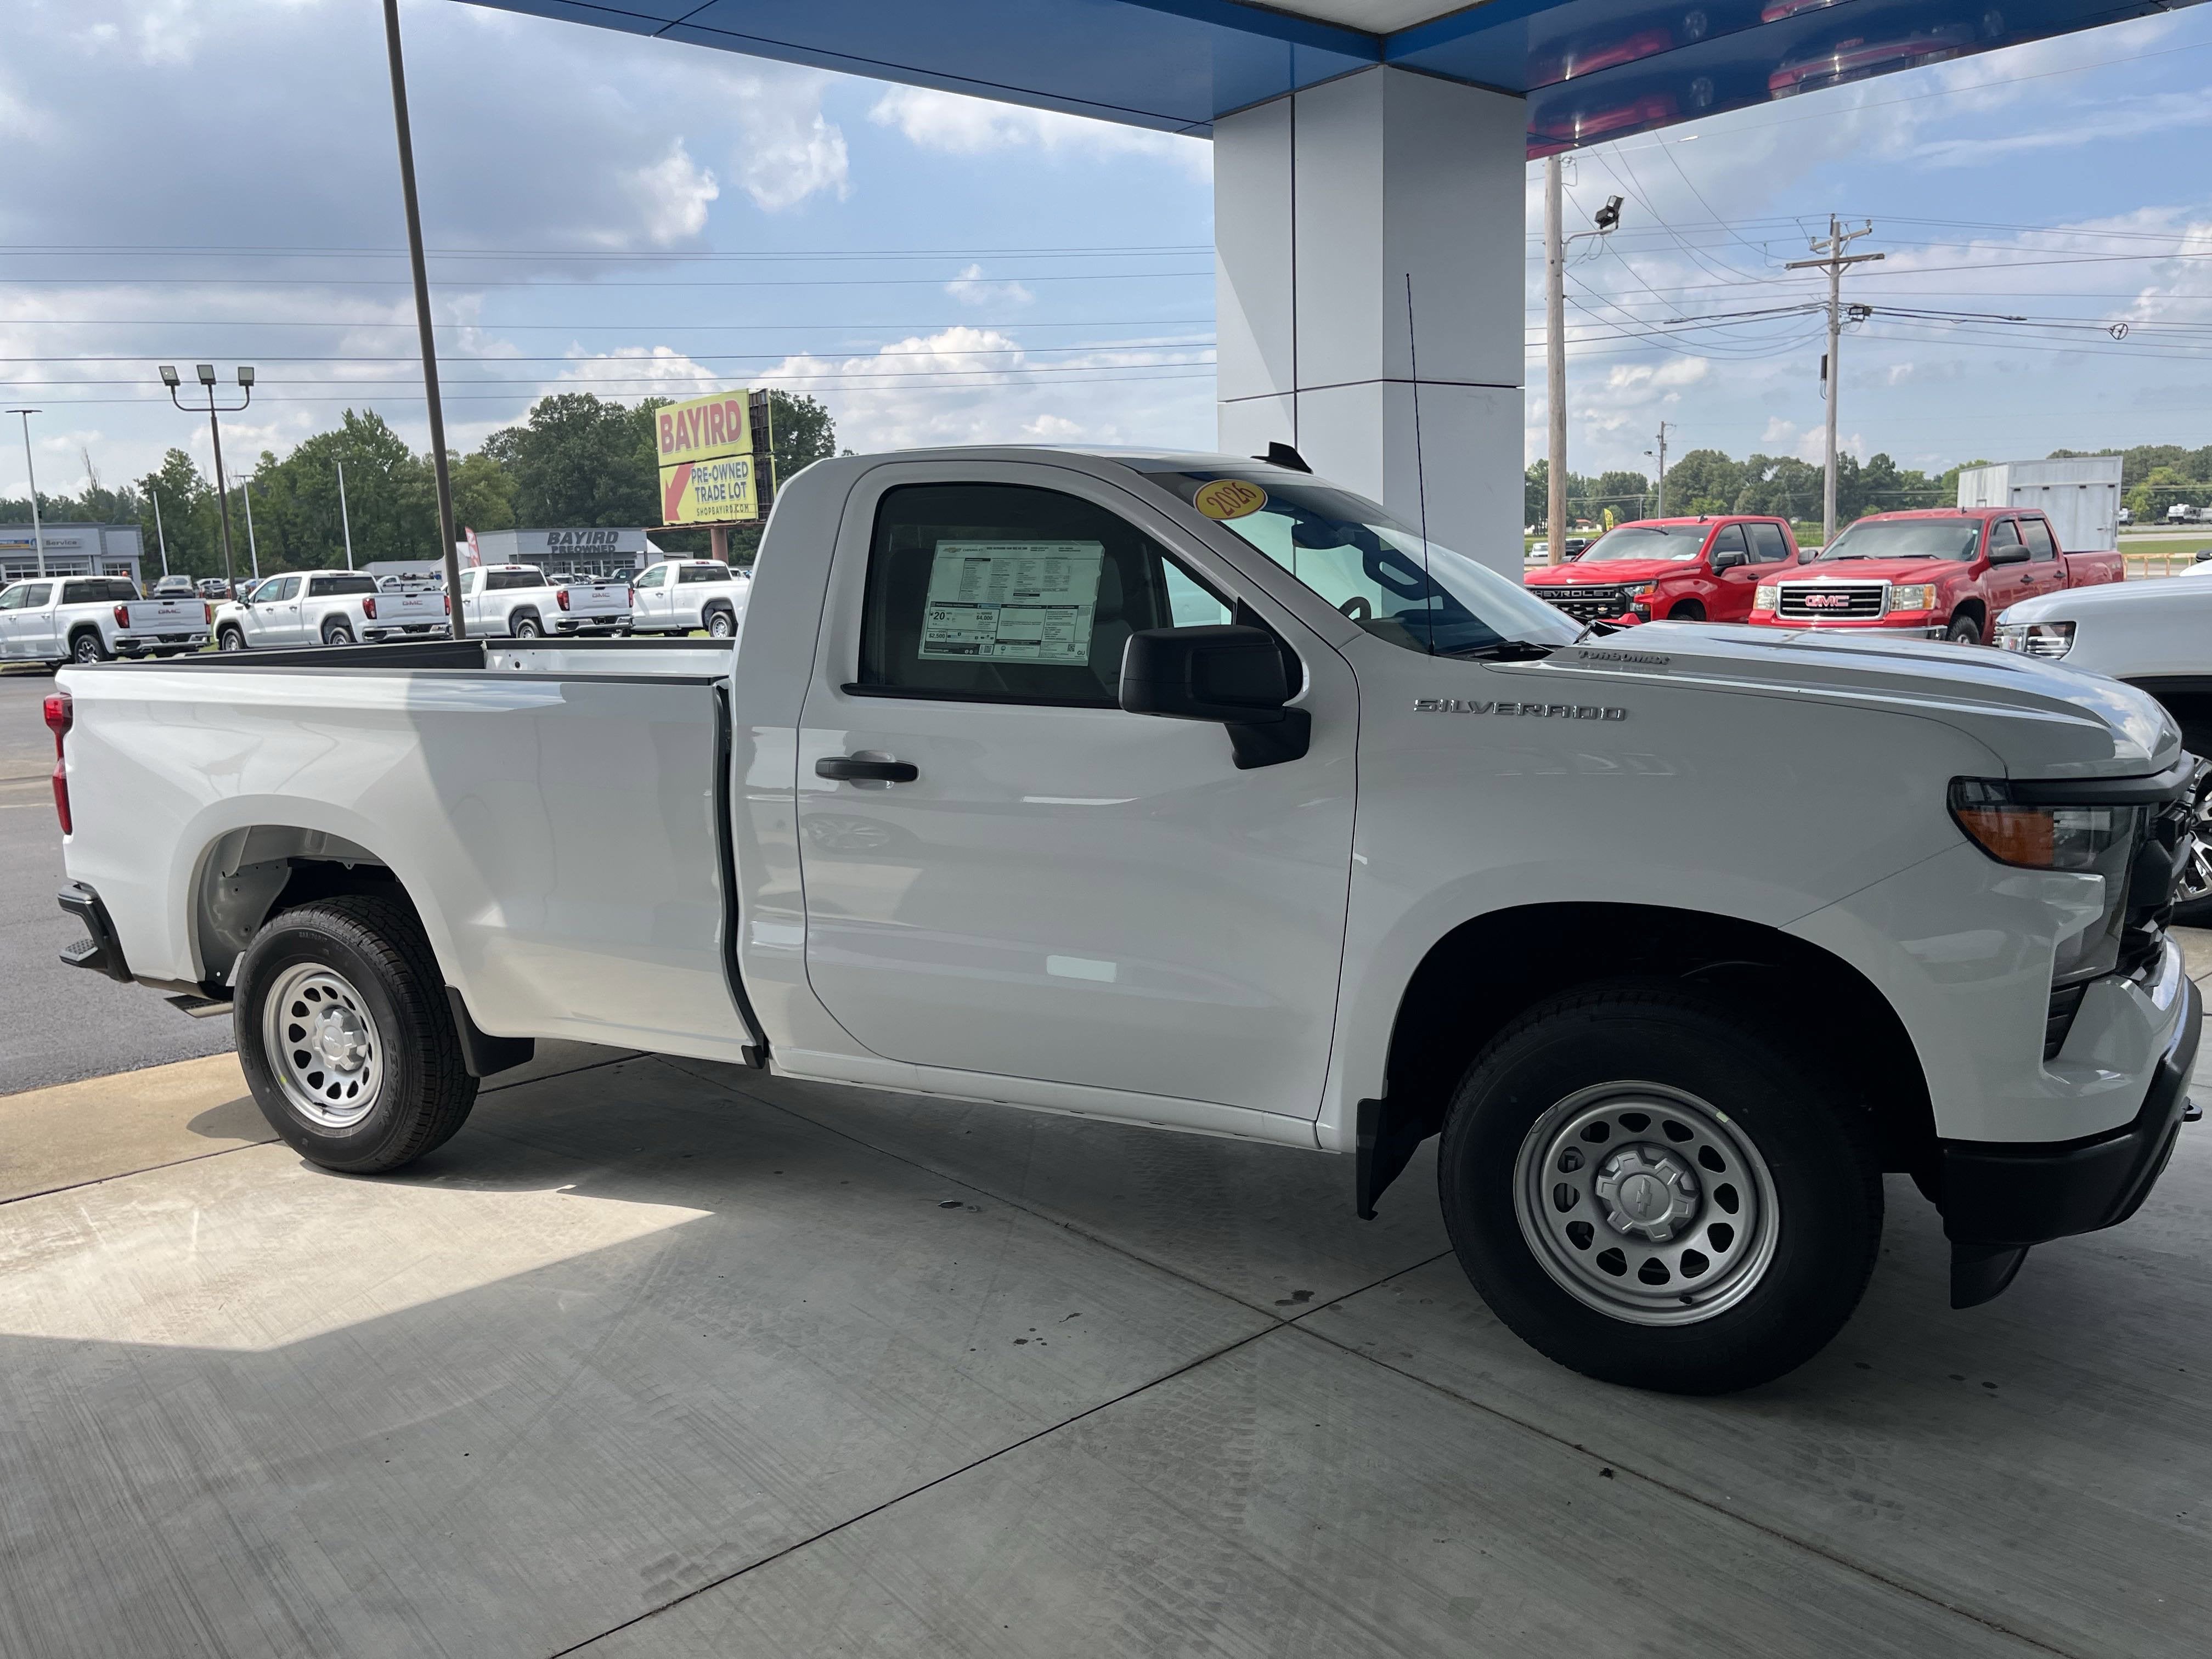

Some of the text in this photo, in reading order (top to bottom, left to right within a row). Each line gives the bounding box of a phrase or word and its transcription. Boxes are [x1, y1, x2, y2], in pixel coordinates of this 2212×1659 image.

[659, 399, 742, 455] BAYIRD
[691, 461, 748, 484] PRE-OWNED
[695, 481, 747, 503] TRADE LOT
[1206, 482, 1256, 516] 2026
[697, 504, 749, 517] SHOPBAYIRD.COM
[547, 531, 619, 545] BAYIRD
[551, 545, 616, 554] PREOWNED
[1805, 595, 1849, 607] GMC
[934, 612, 945, 620] 20
[1413, 698, 1628, 721] SILVERADO
